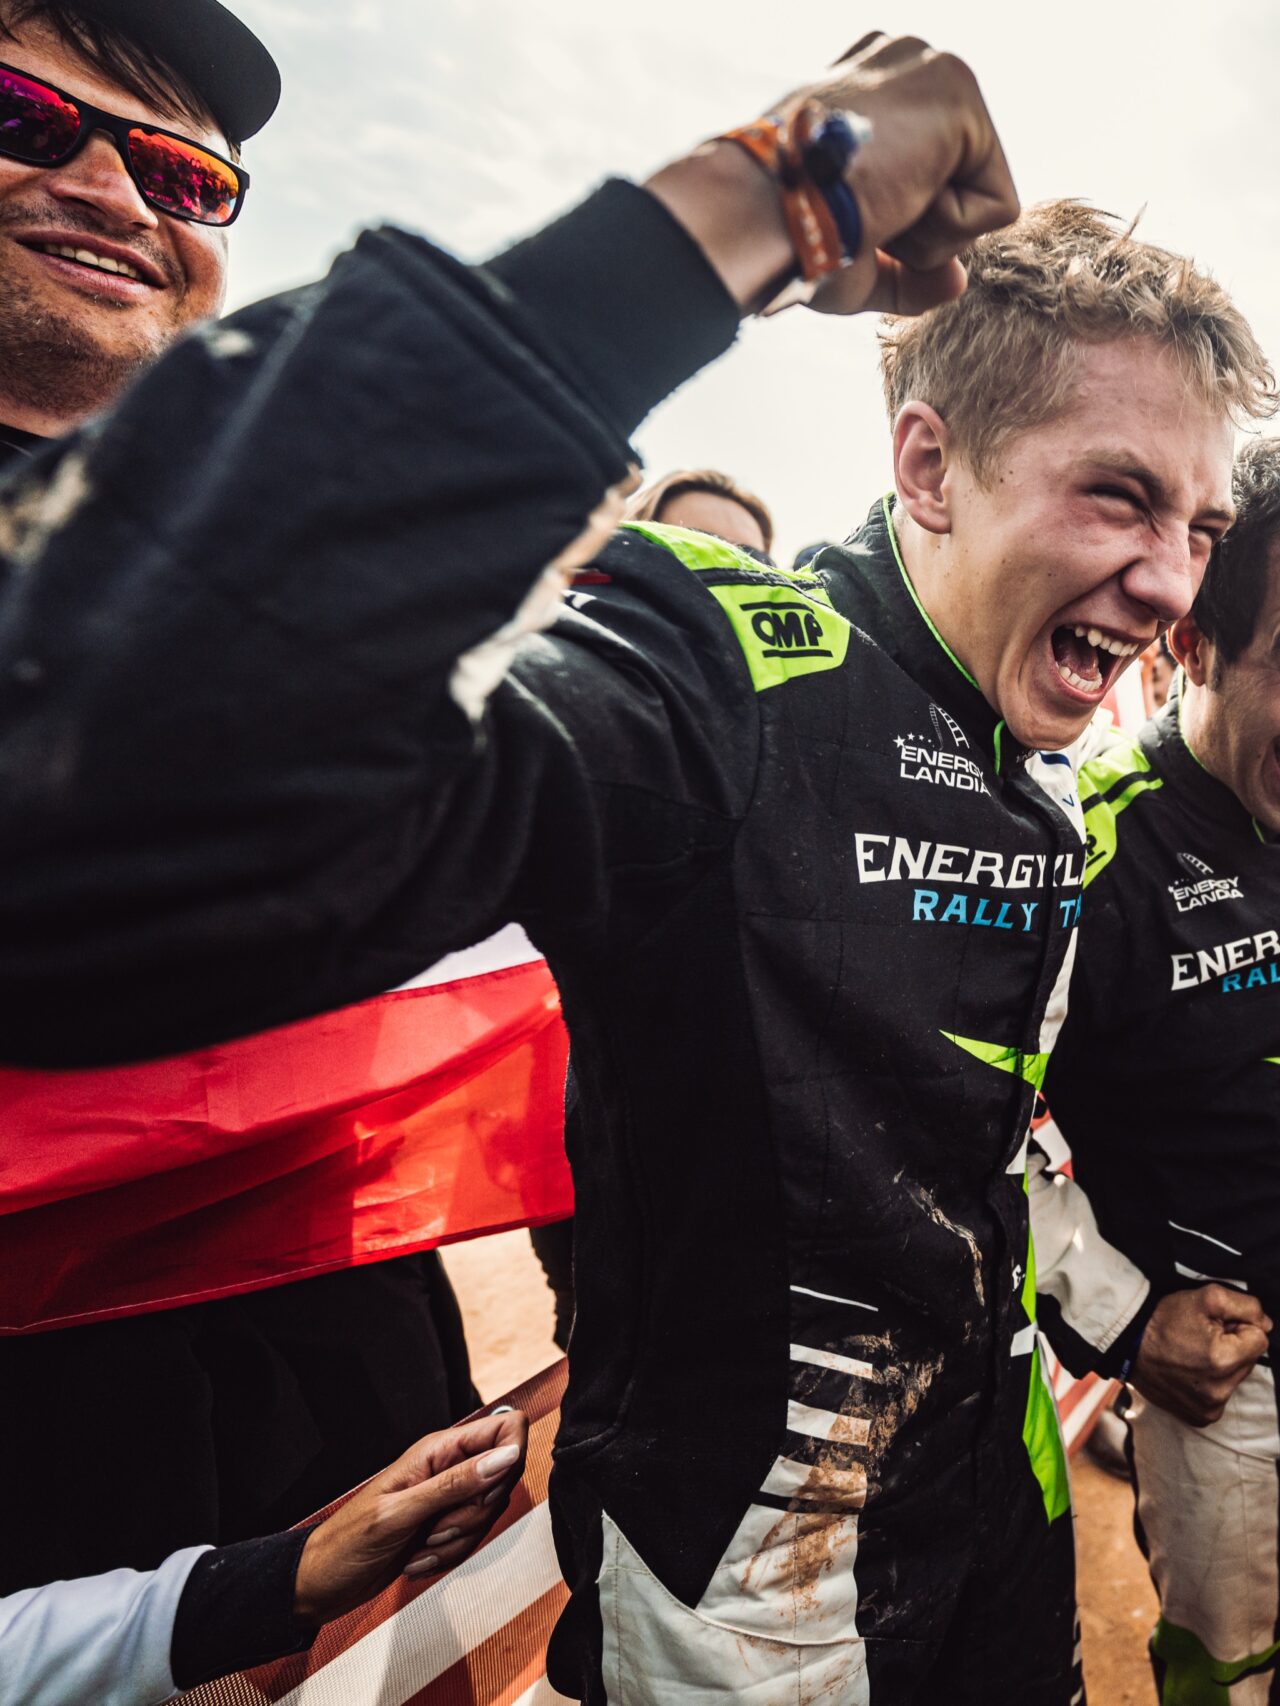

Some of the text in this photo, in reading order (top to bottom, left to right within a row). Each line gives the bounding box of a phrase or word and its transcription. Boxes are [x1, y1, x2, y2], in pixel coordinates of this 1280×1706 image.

[751, 611, 824, 648] OMP
[900, 745, 984, 778] ENERGY
[900, 762, 992, 797] LANDIA
[854, 832, 1086, 889] ENERGYL
[1173, 876, 1240, 901] ENERGY
[912, 889, 1038, 932] RALLY
